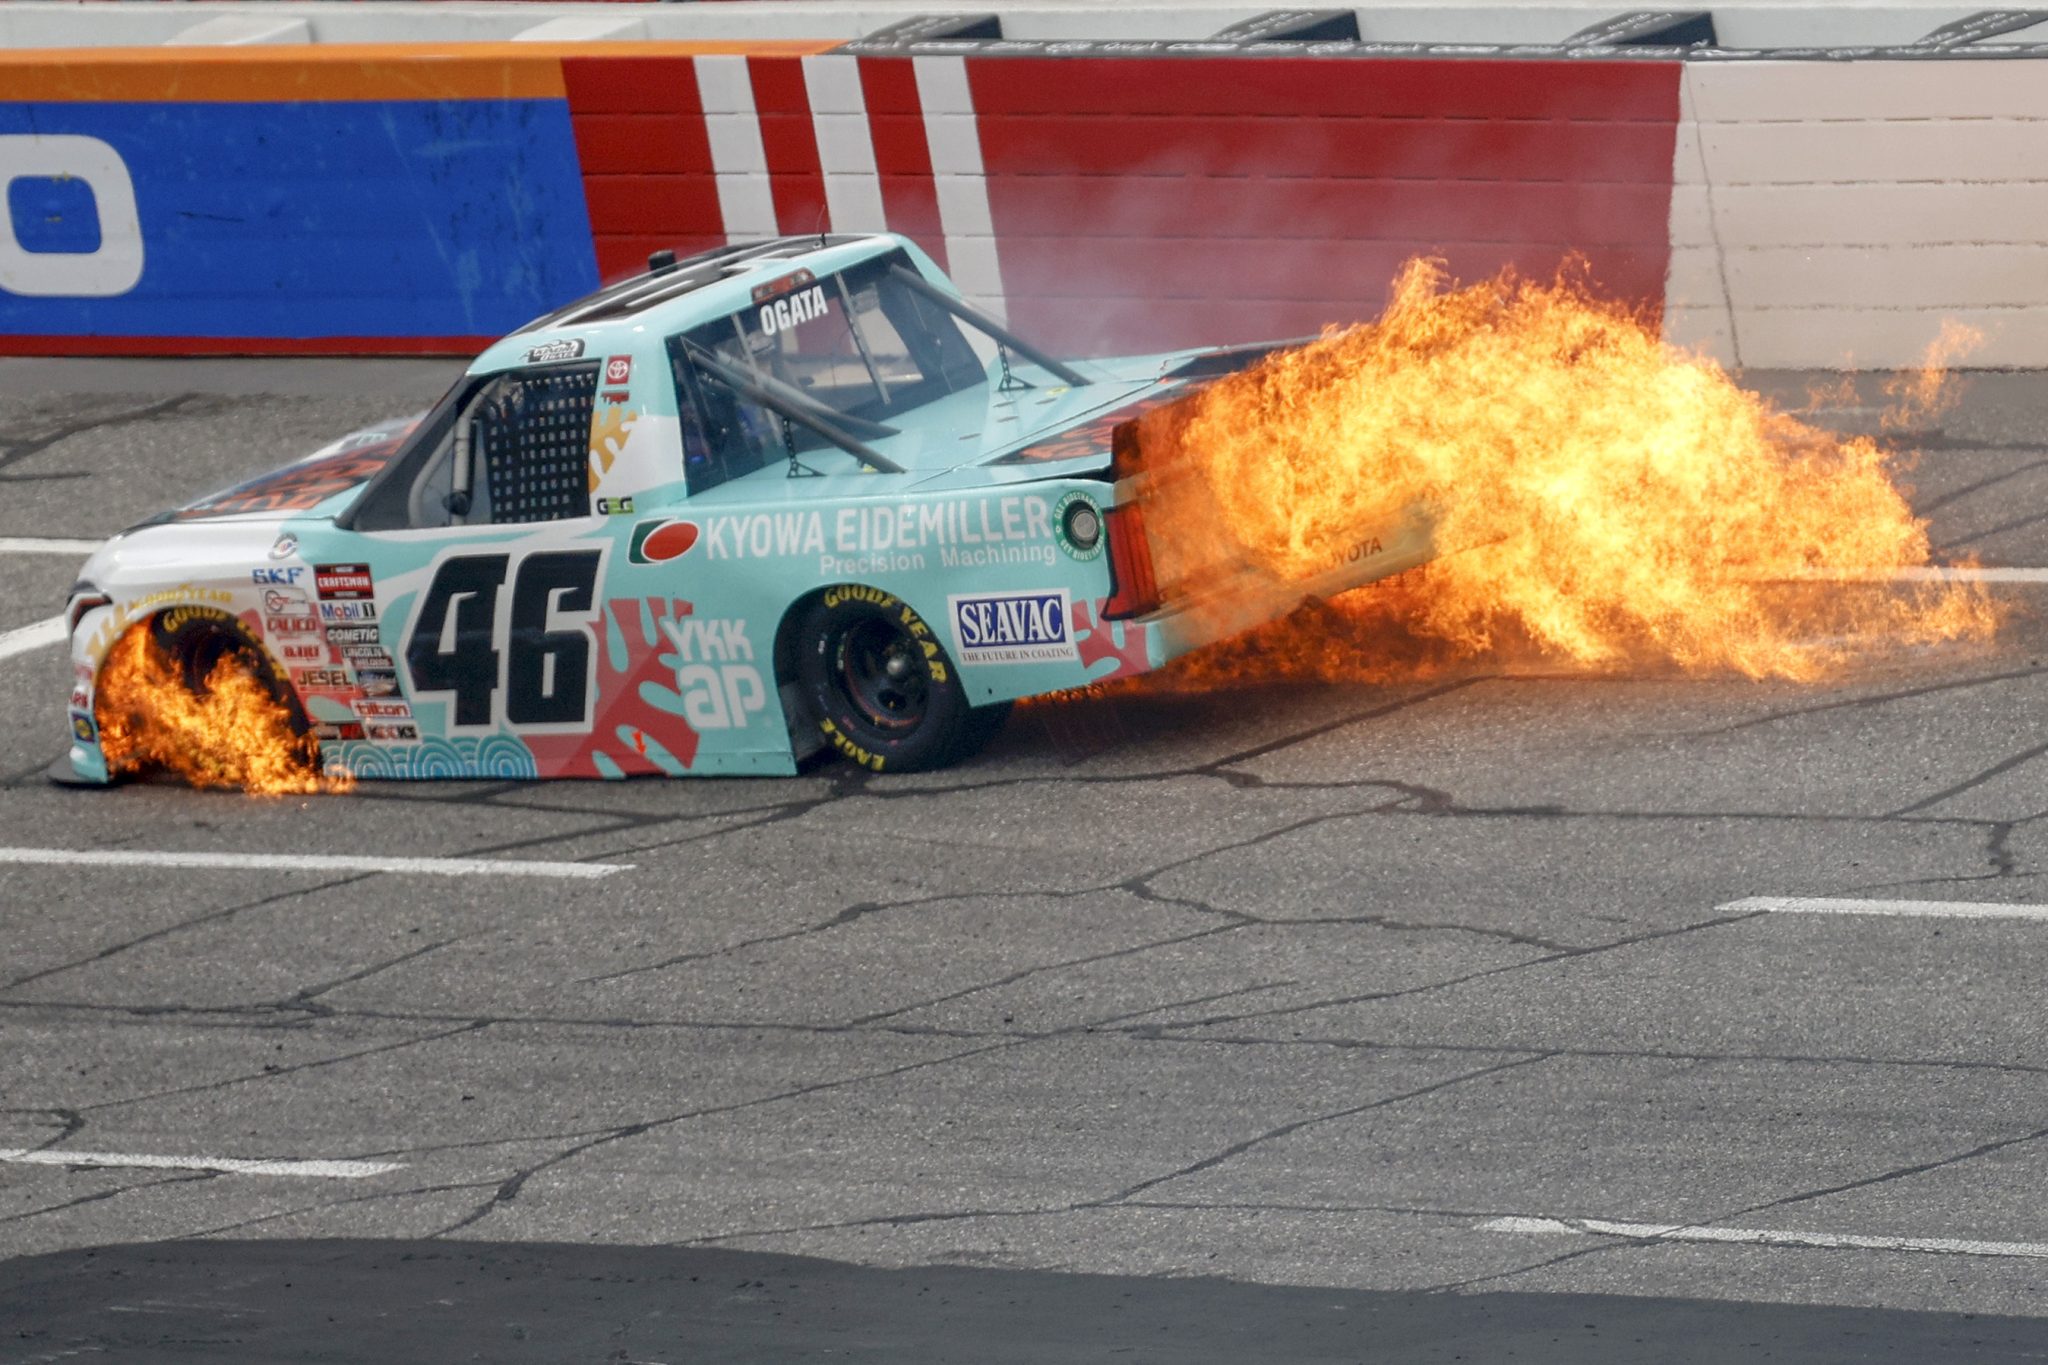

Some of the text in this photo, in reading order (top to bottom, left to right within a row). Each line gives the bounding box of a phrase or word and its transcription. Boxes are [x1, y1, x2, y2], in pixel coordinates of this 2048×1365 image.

[760, 285, 828, 336] OGATA
[706, 495, 1052, 560] KYOWA EIDEMILLER
[820, 543, 1057, 576] Precision Machining
[252, 567, 304, 585] SKF
[318, 576, 369, 588] CRAFTSMAN
[321, 602, 376, 619] Mobil 1
[960, 598, 1062, 643] SEAVAC
[327, 628, 378, 641] COMETIC
[405, 549, 603, 726] 46
[663, 619, 755, 662] YKK
[824, 584, 948, 684] GOODYEAR
[343, 646, 384, 658] LINCOLN
[962, 647, 1074, 661] THE FUTURE IN COATING
[297, 670, 352, 686] JESEL
[355, 702, 409, 716] tilton
[679, 664, 766, 729] ap
